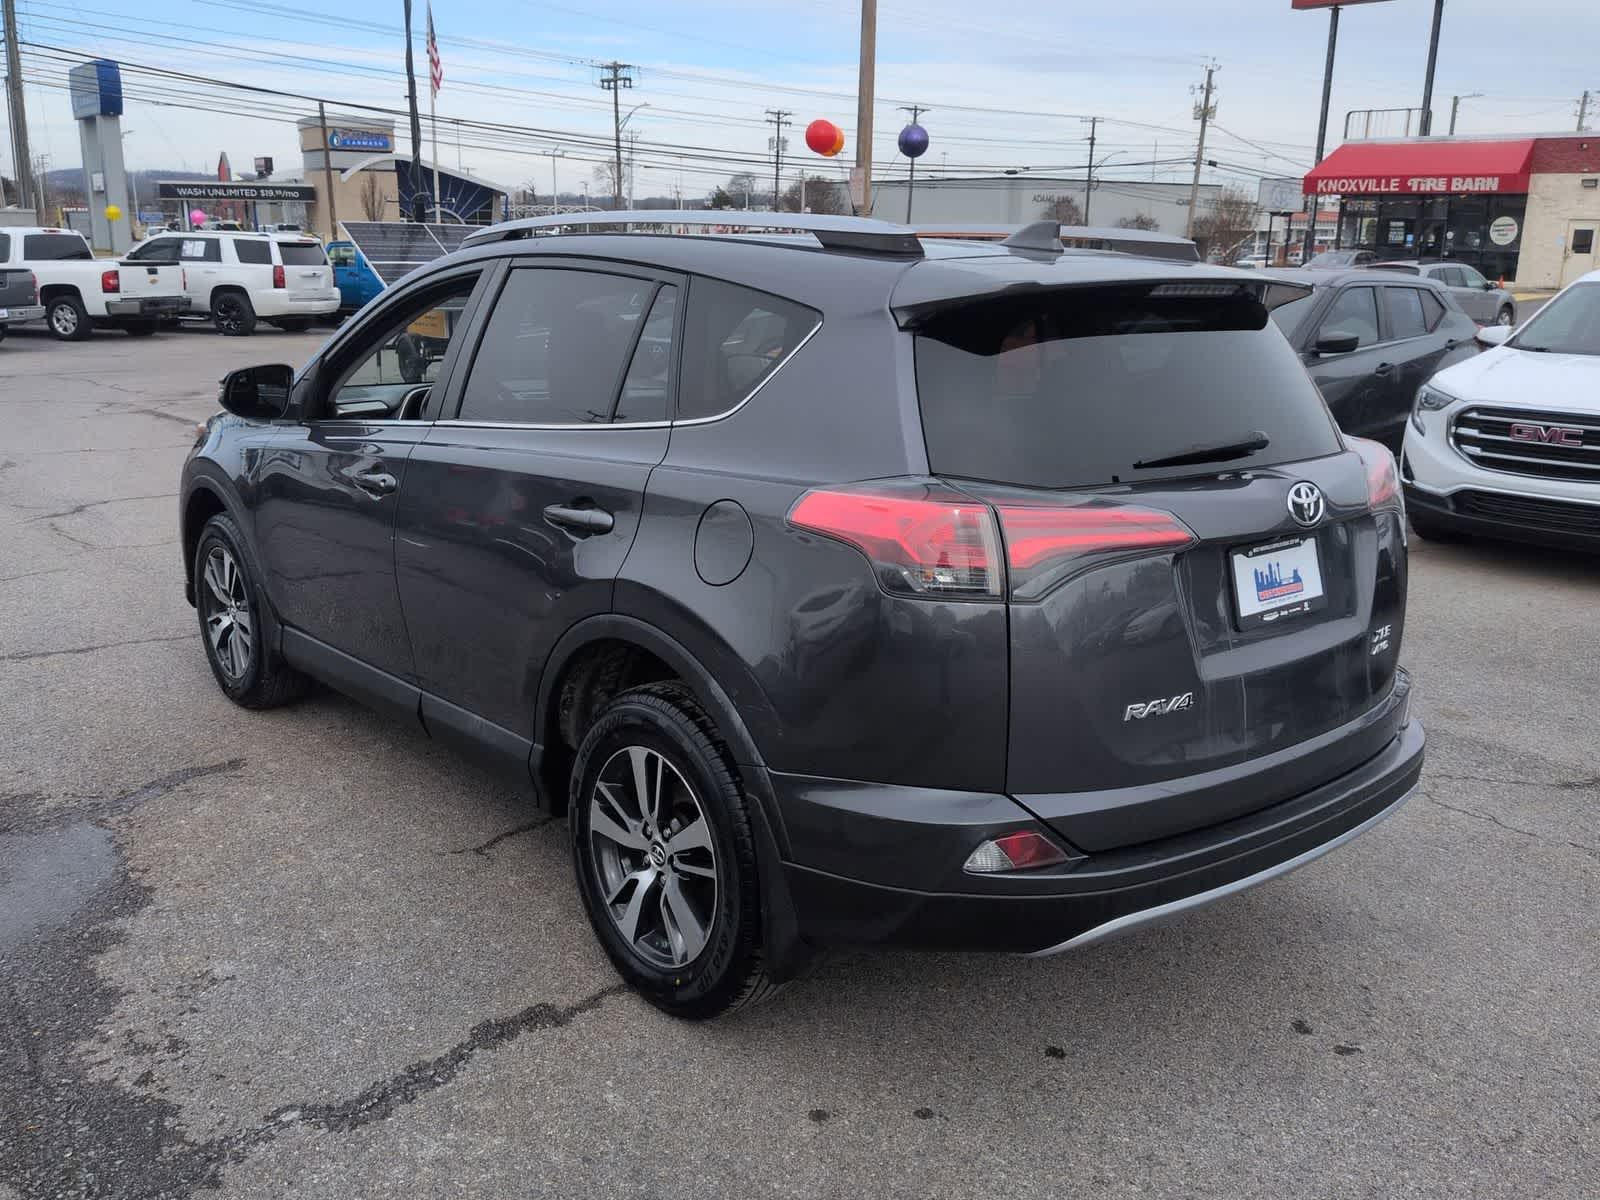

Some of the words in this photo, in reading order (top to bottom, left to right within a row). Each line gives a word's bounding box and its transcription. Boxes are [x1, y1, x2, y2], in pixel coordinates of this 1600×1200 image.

[176, 187, 206, 197] WASH
[207, 188, 257, 197] UNLIMITED
[1317, 178, 1400, 193] KNOXVILLE
[1407, 176, 1448, 192] TIRE
[1451, 176, 1500, 191] BARN
[1509, 423, 1585, 447] GMC
[1124, 692, 1194, 721] RAV4
